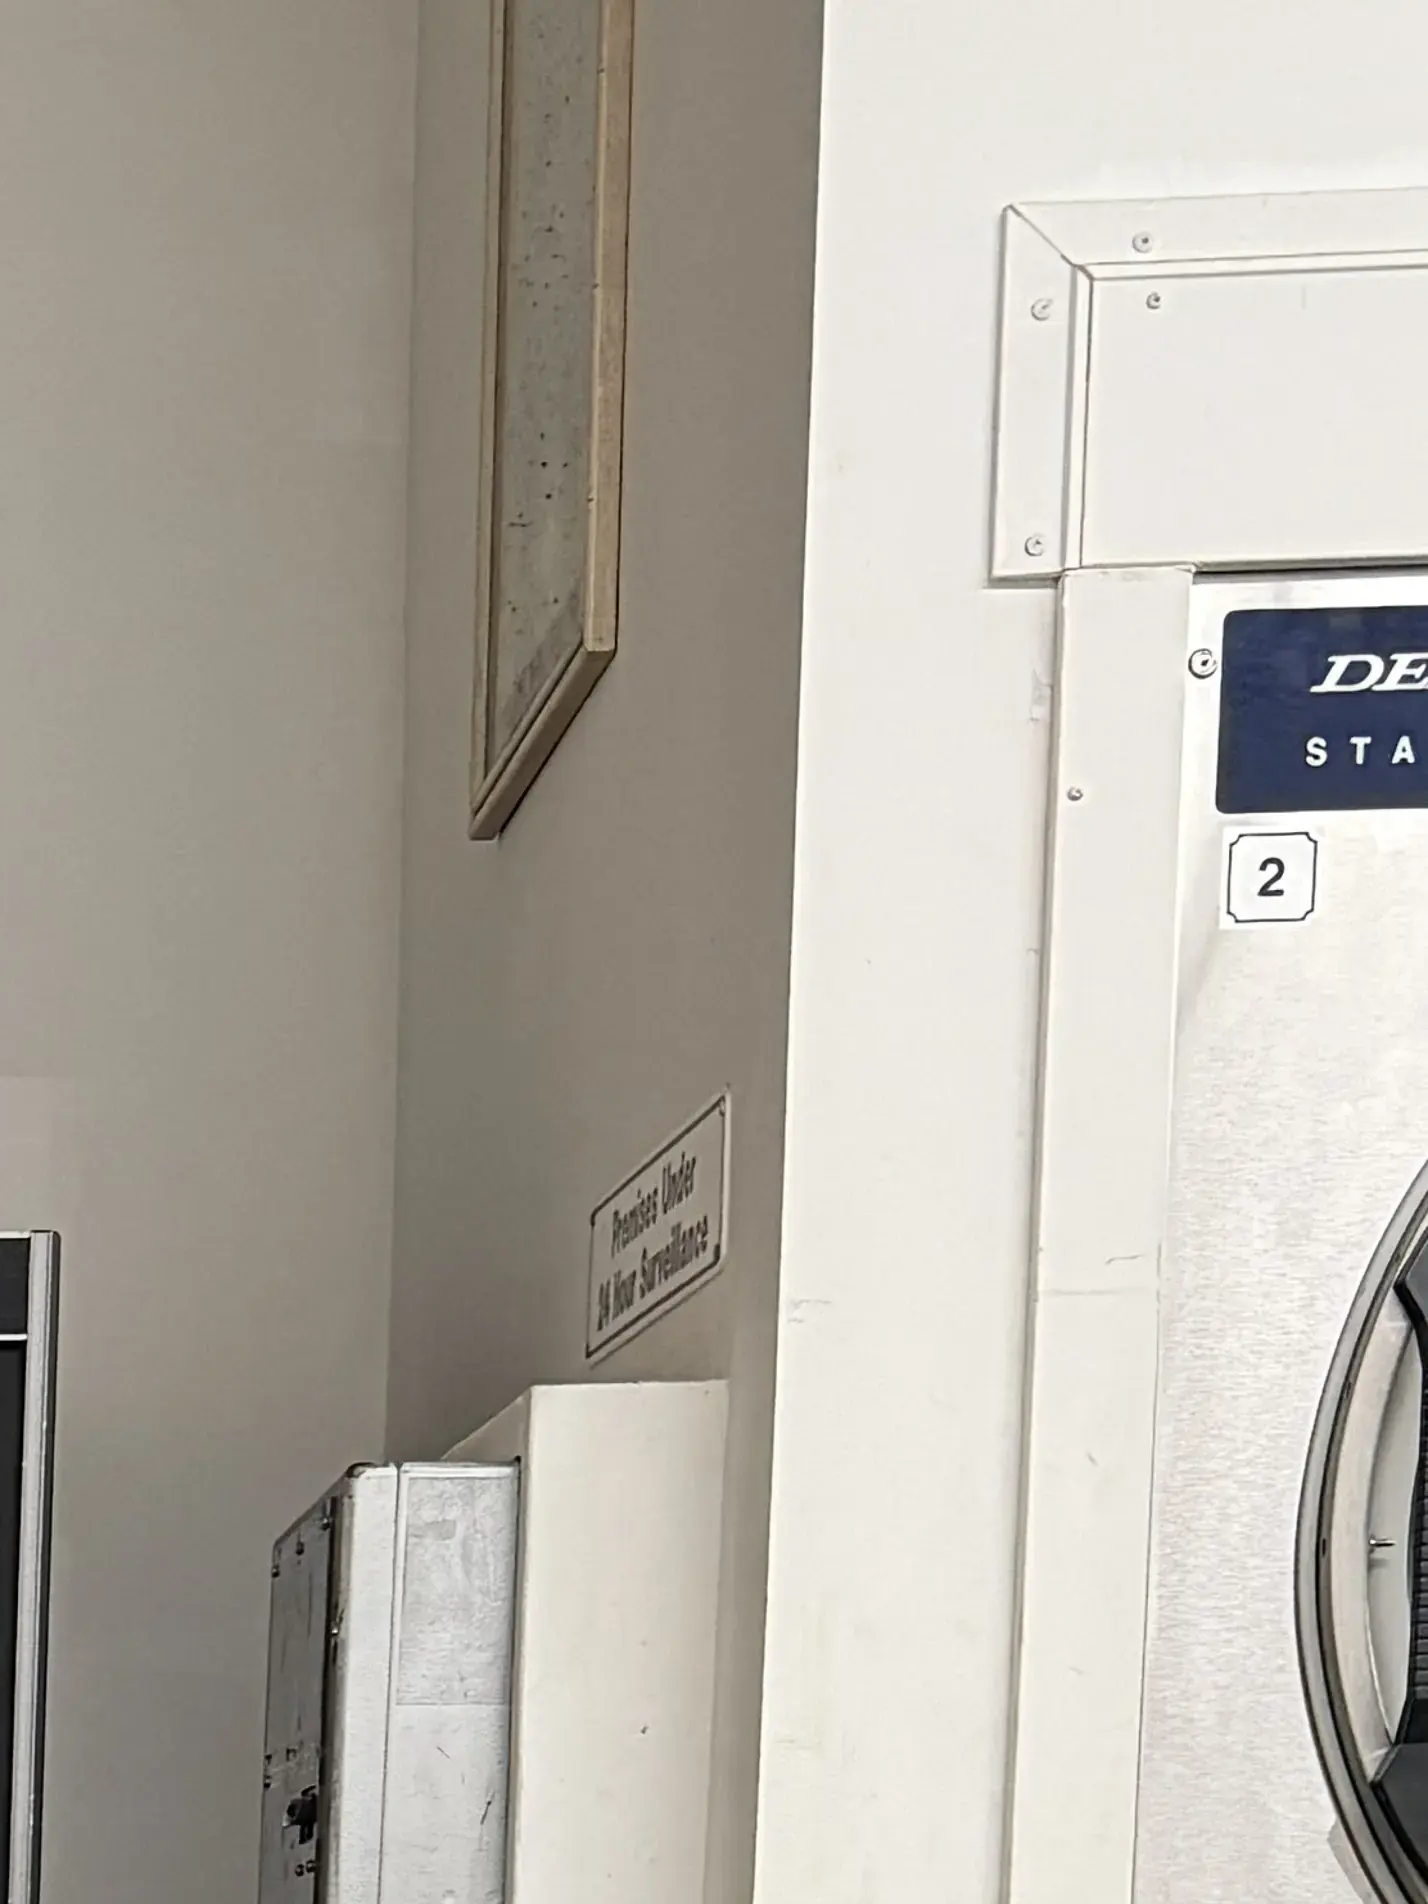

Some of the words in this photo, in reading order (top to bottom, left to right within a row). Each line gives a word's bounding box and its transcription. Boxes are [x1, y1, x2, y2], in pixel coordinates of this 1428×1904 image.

[1305, 735, 1415, 768] STA
[1257, 856, 1285, 897] 2
[611, 1187, 658, 1259] Premises
[661, 1151, 696, 1215] Under
